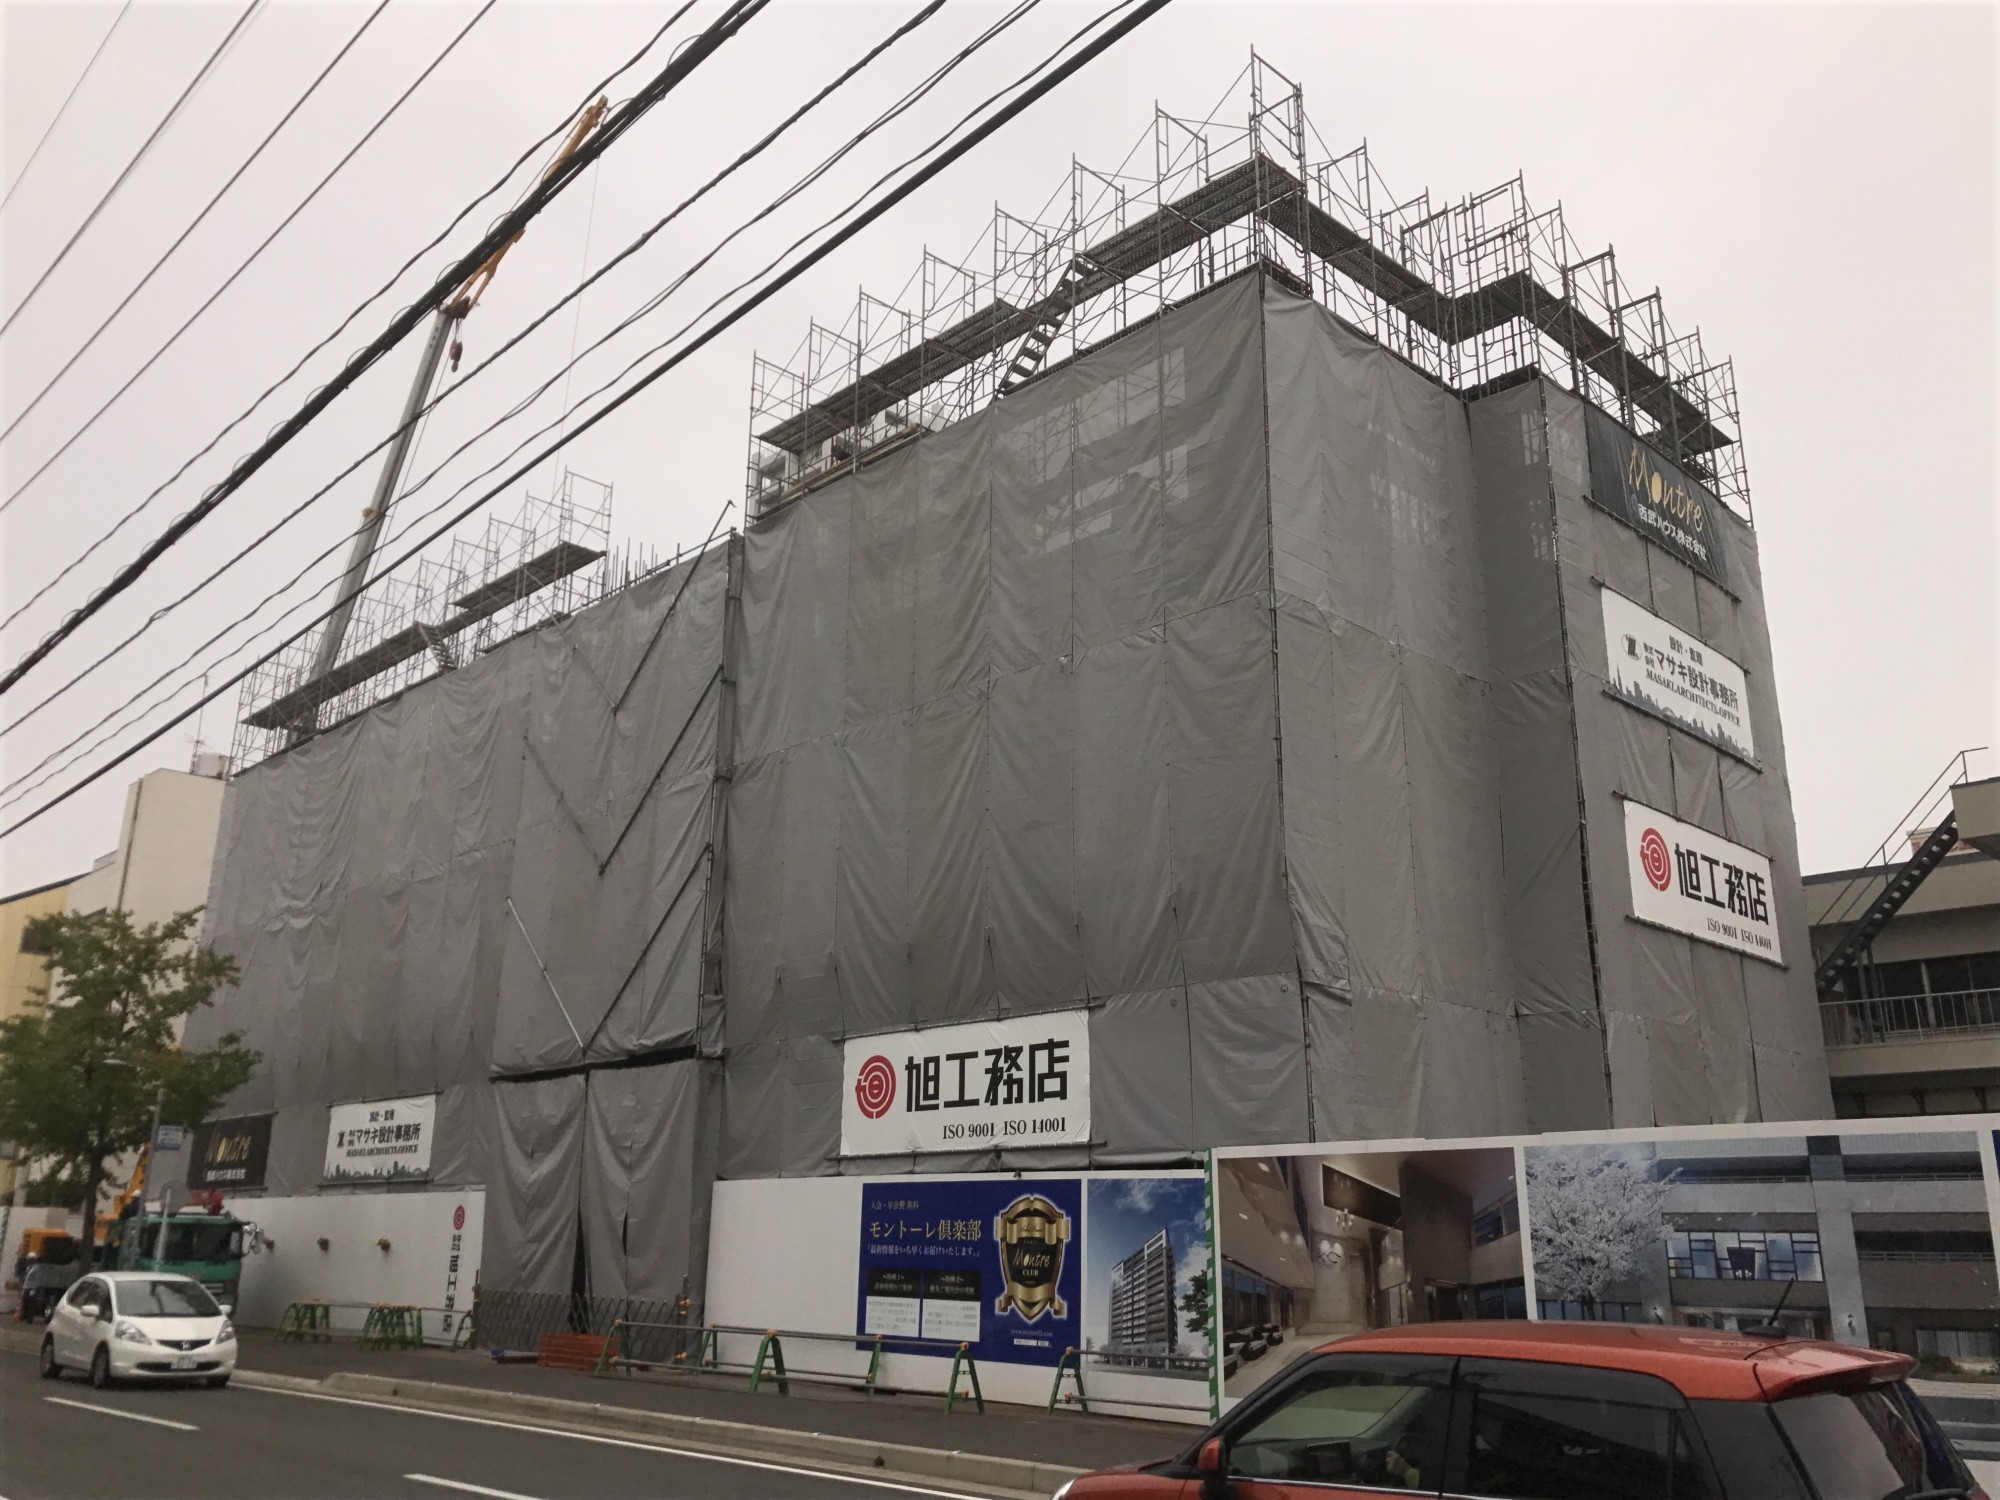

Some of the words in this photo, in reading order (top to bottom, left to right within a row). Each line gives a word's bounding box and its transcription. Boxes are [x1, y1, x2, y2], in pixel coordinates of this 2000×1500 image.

[1629, 444, 1704, 533] Montre
[1674, 842, 1769, 925] 旭工務店
[1707, 917, 1720, 933] ISO
[1722, 924, 1738, 939] 9001
[1741, 929, 1753, 944] ISO
[905, 1038, 1070, 1113] 旭工務店
[943, 1124, 965, 1139] ISO
[968, 1122, 995, 1137] 9001
[1003, 1119, 1027, 1135] ISO
[1031, 1117, 1066, 1134] 14001
[1013, 1249, 1050, 1268] Montre
